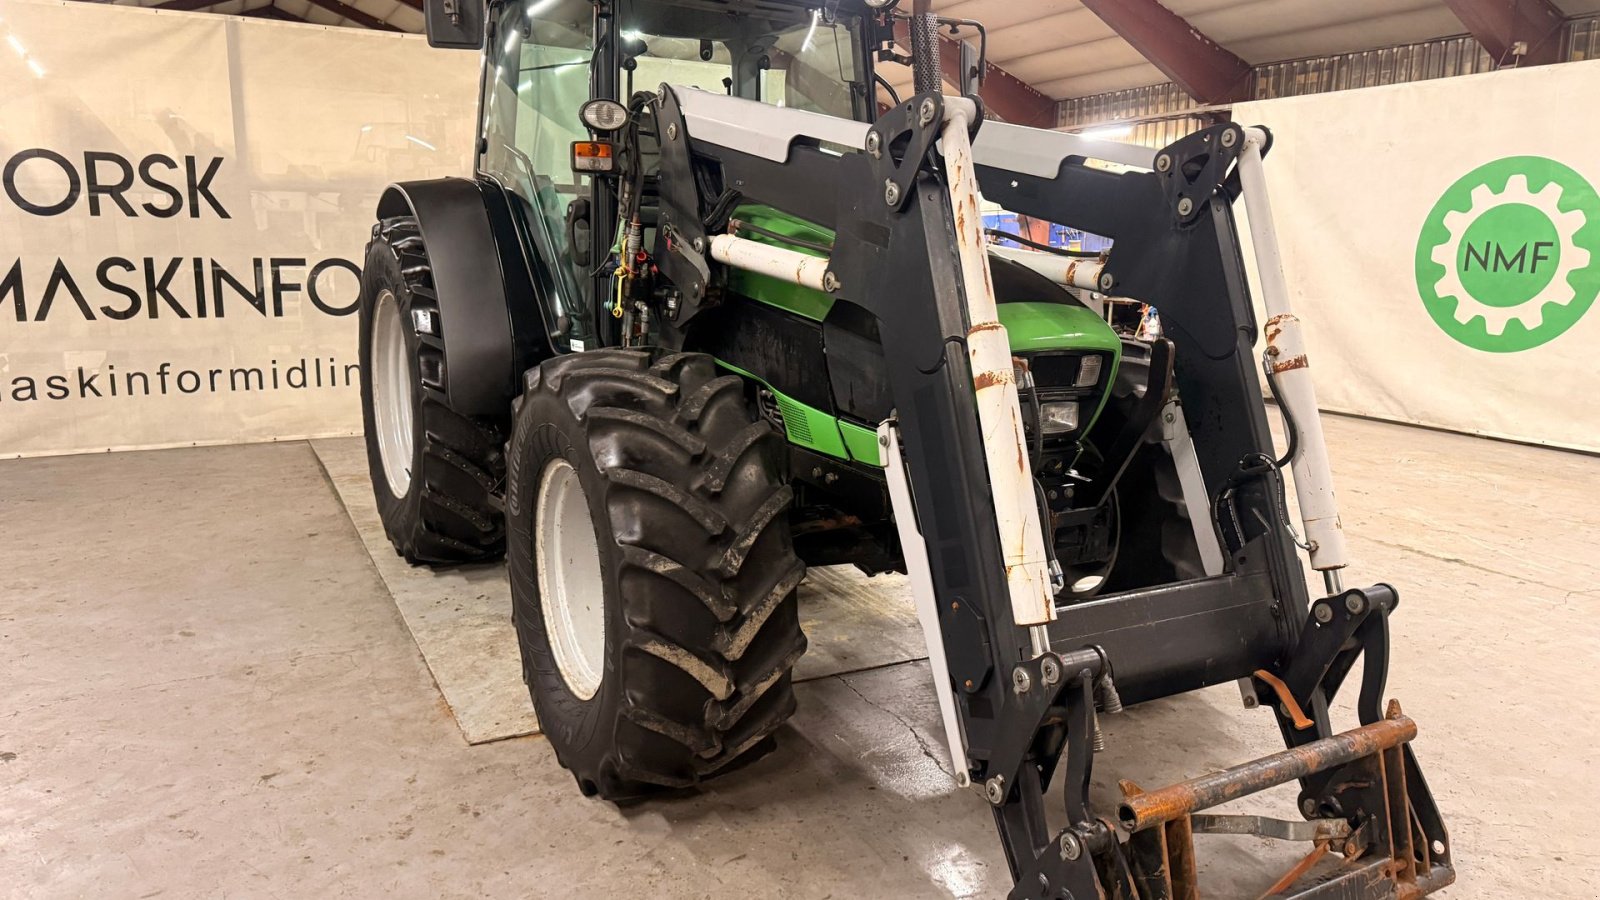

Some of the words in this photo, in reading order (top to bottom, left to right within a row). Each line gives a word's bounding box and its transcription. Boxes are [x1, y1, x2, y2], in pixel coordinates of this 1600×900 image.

[2, 148, 232, 219] ORSK
[1463, 241, 1554, 274] NMF
[0, 357, 361, 402] askinformidlin
